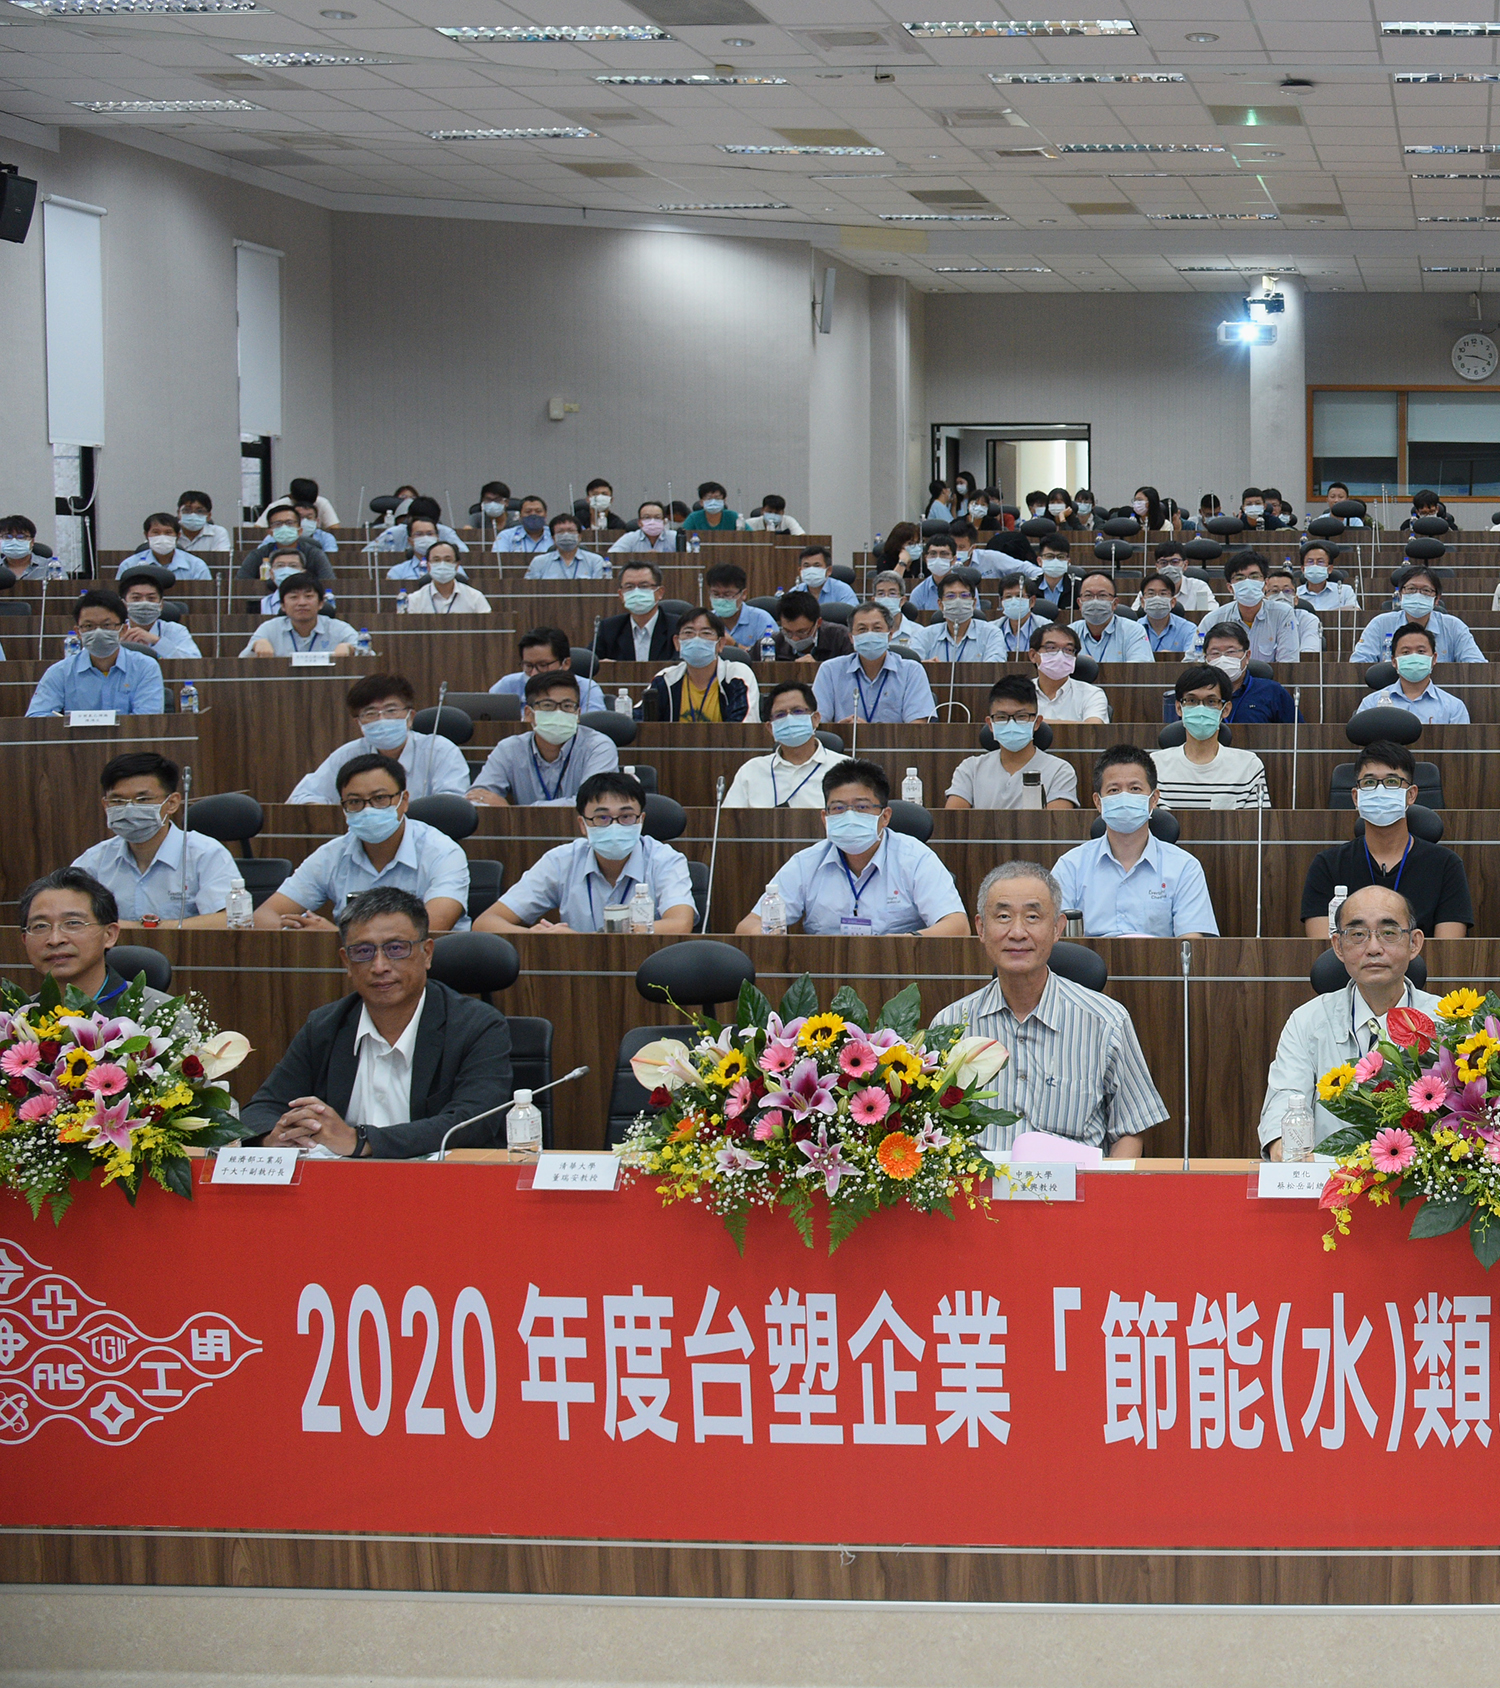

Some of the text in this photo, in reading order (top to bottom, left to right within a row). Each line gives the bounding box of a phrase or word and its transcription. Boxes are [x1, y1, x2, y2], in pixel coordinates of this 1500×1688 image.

[228, 1155, 283, 1165] 經濟部工業局
[559, 1162, 597, 1170] 清華大學
[221, 1167, 285, 1177] 于大千副執行長
[1015, 1170, 1053, 1179] 中興大學
[1292, 1170, 1311, 1179] 塑化
[298, 1283, 496, 1438] 2020
